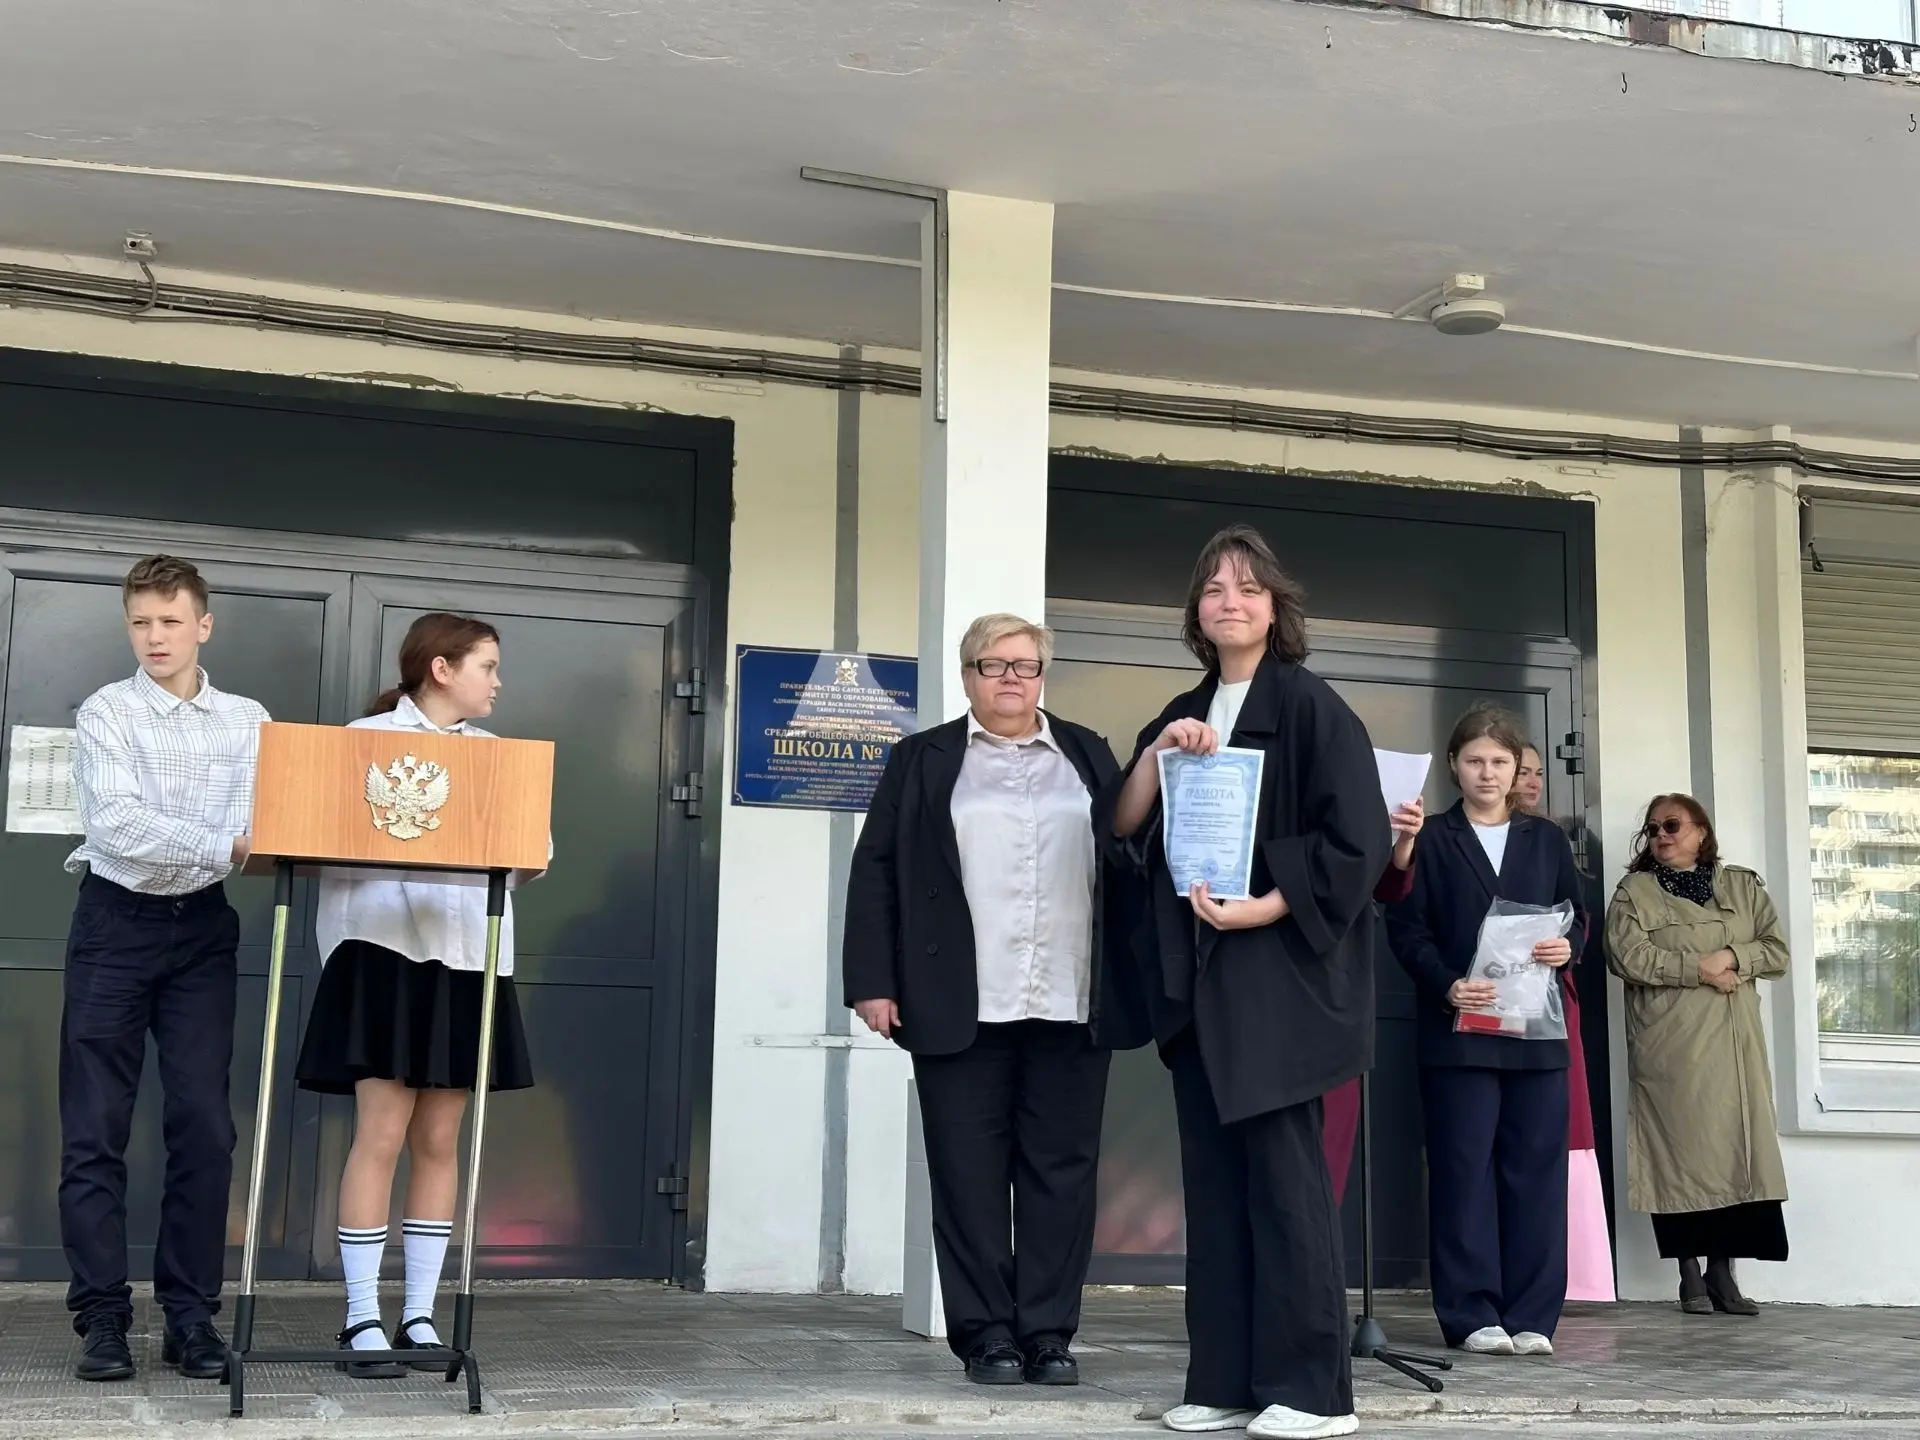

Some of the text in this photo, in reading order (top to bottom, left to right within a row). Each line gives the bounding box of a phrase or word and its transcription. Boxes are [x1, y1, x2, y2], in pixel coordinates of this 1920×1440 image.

[780, 682, 910, 698] ПРАВИТЕЛЬСТВО САНКТ-ПЕТЕРБУРГА
[795, 691, 829, 699] КОМИТЕТ
[843, 694, 896, 704] ОБРАЗОВАНИЮ
[764, 728, 807, 738] СРЕДНЯЯ
[773, 739, 883, 761] ШКОЛА №
[1185, 787, 1236, 800] ГРАМОТА
